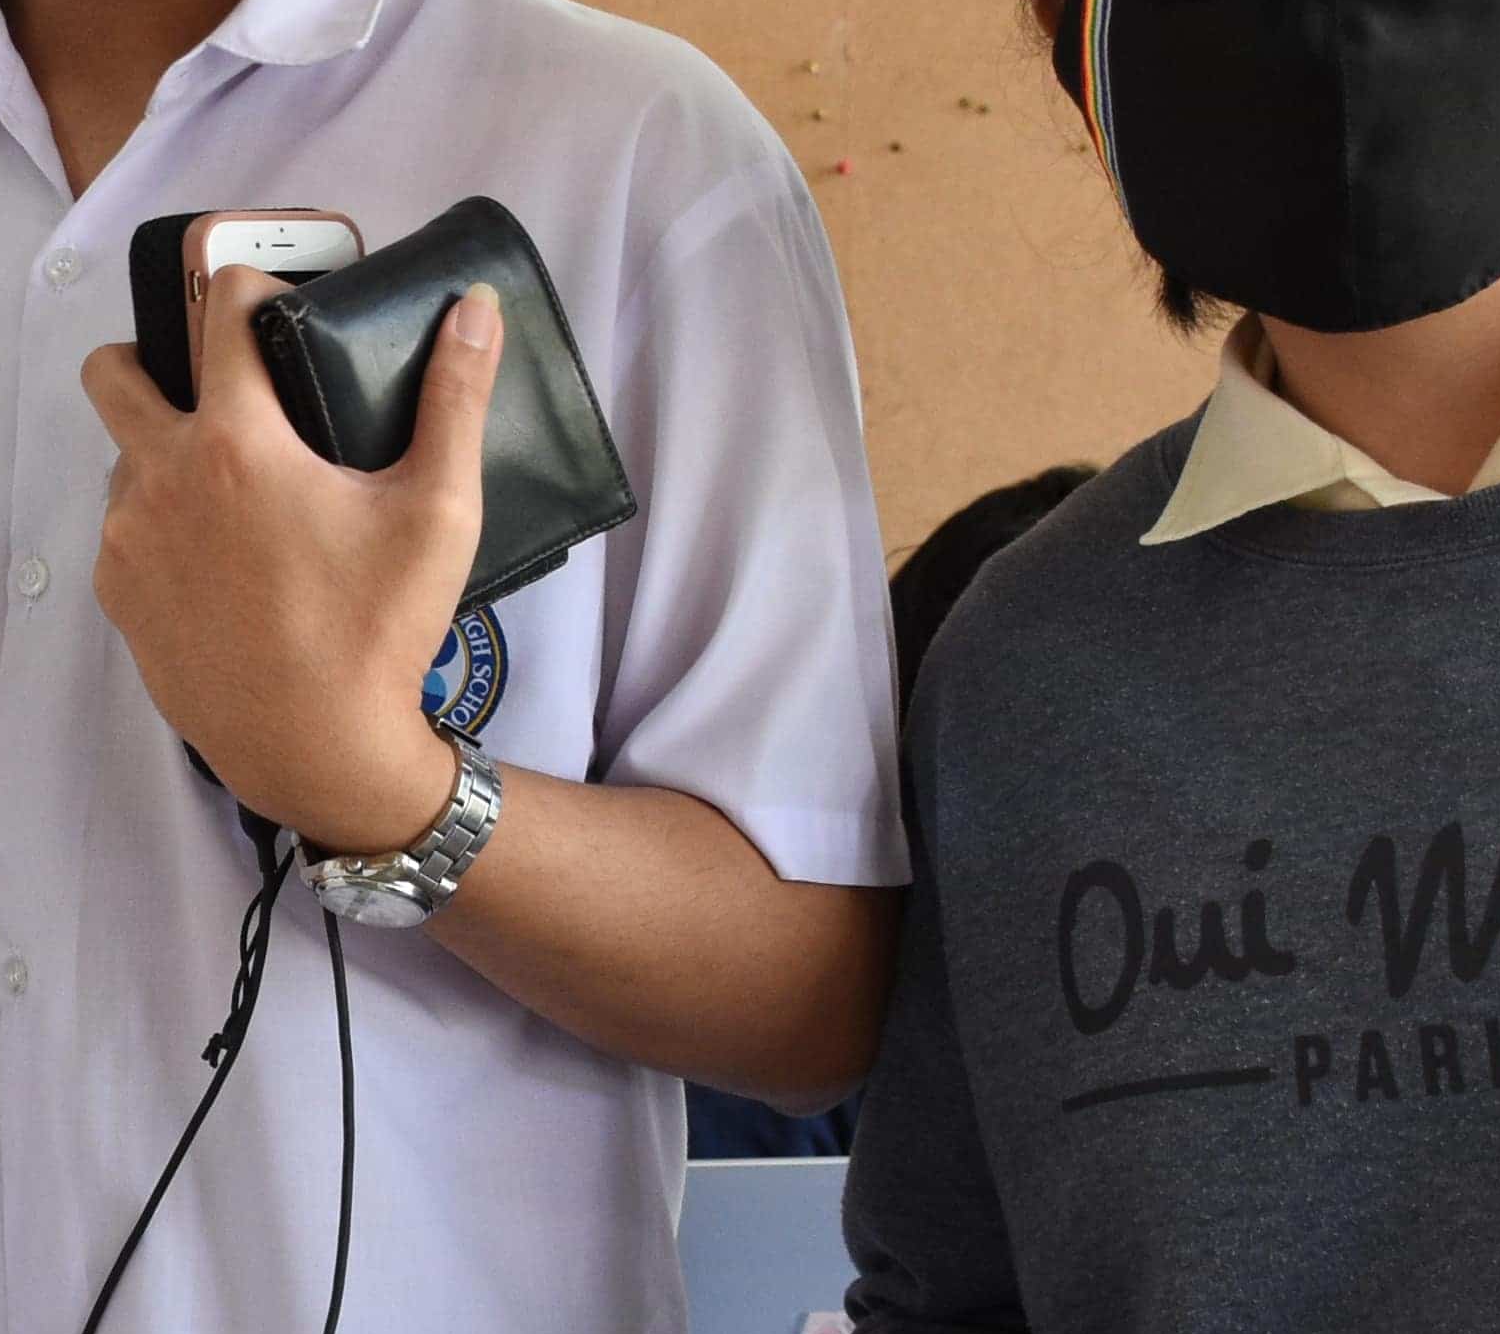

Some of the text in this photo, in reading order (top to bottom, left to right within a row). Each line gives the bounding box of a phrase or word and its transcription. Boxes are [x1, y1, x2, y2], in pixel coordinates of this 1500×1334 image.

[450, 613, 492, 726] IGH SCHO
[1059, 838, 1296, 1035] Oui
